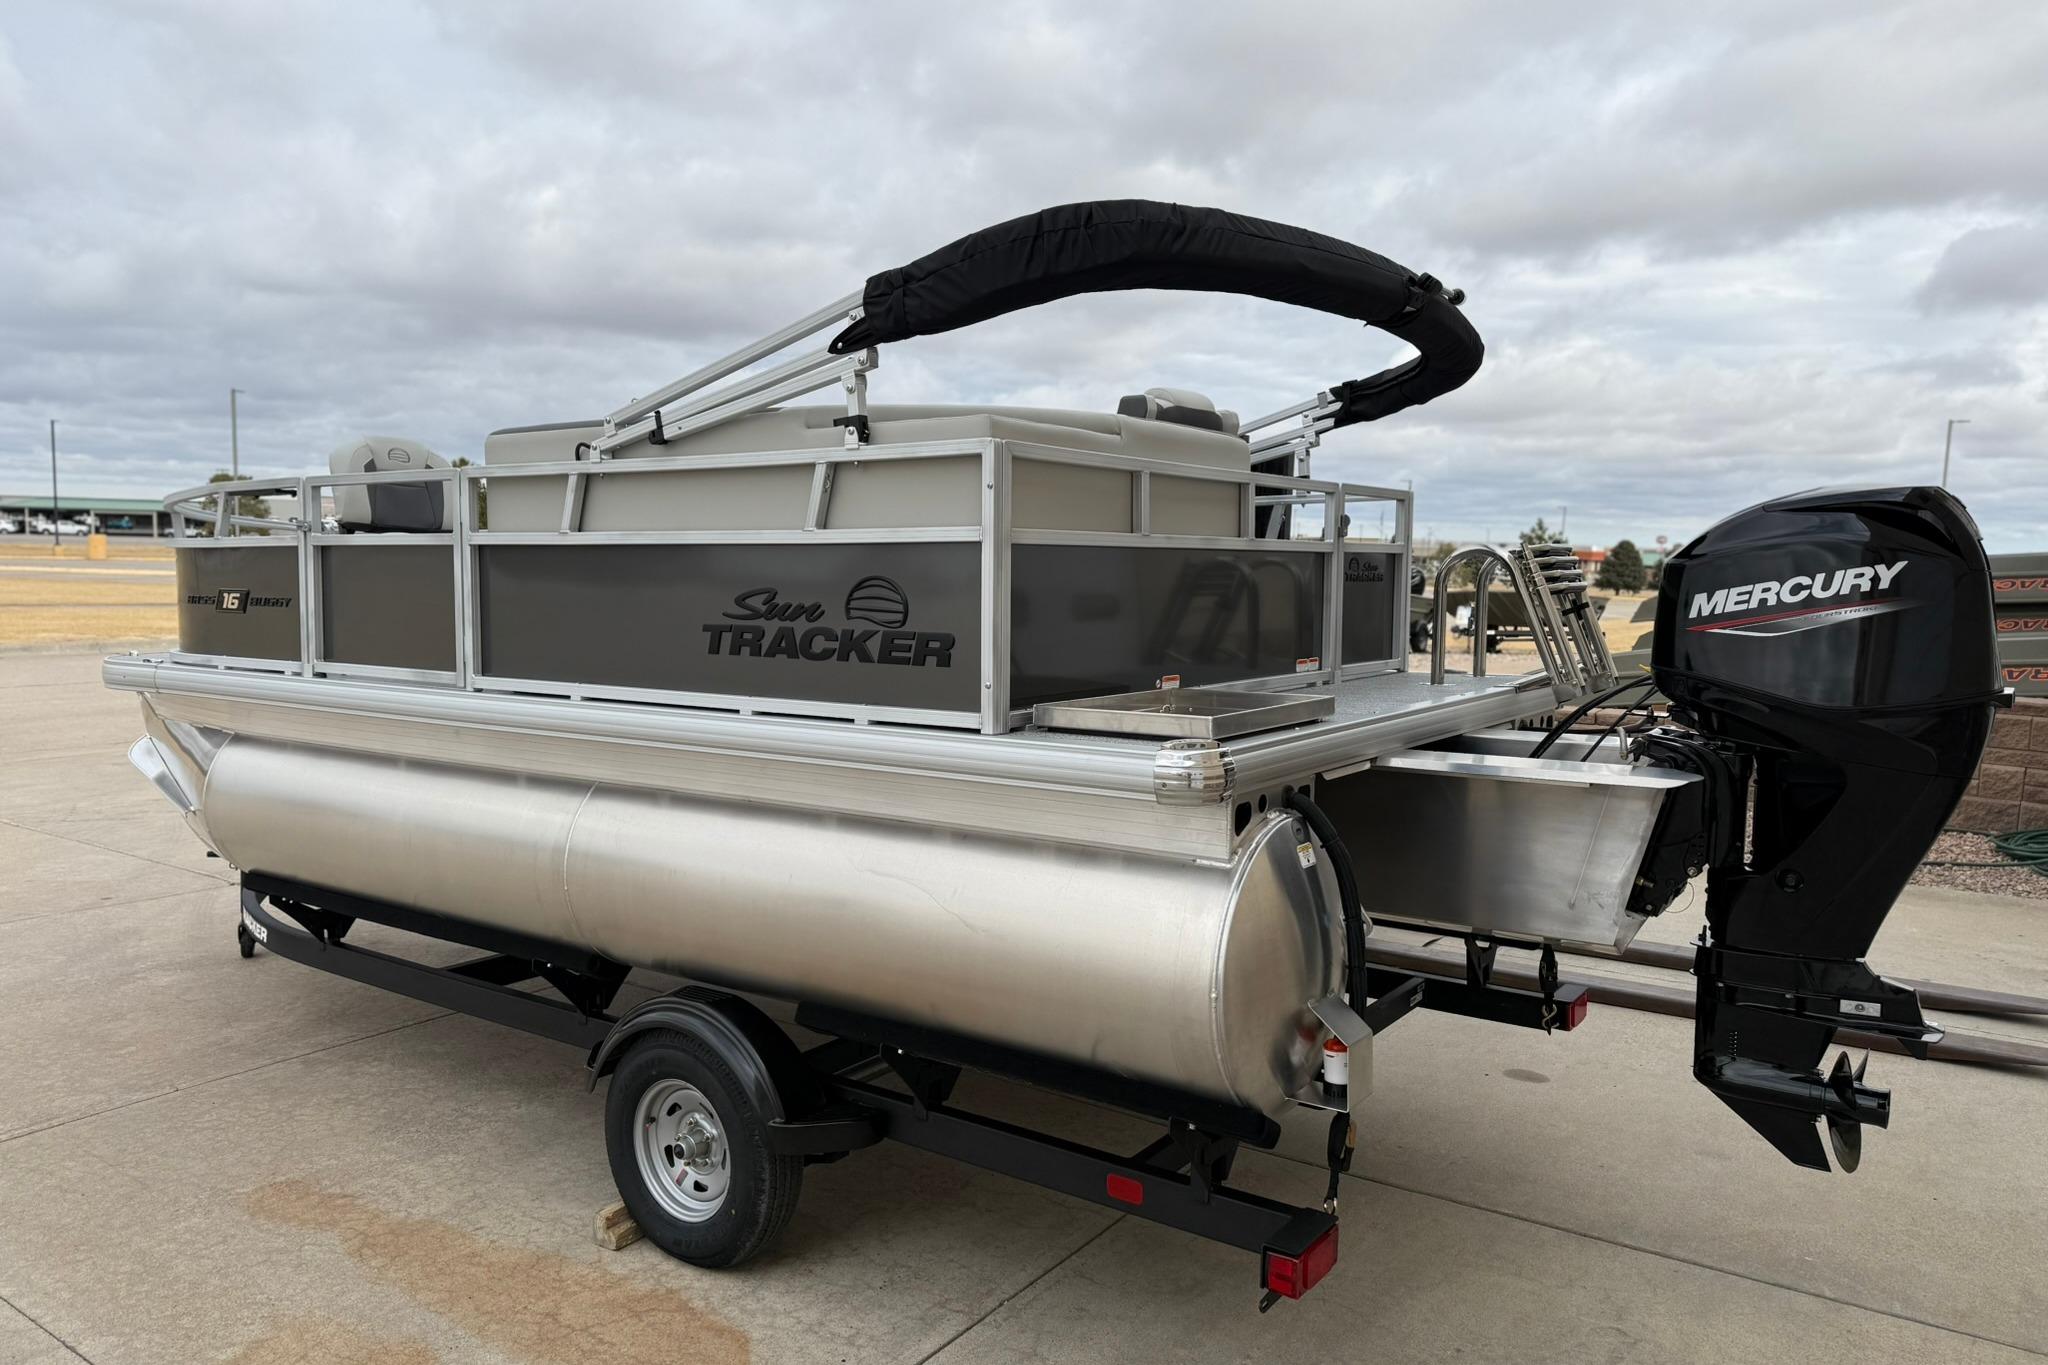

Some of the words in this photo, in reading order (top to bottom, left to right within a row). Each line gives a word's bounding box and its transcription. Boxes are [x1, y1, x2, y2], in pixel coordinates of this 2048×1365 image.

[222, 592, 240, 609] 16
[249, 596, 293, 608] BUGGY
[721, 586, 826, 623] Sun
[1688, 560, 1909, 619] MERCURY
[702, 623, 956, 668] TRACKER
